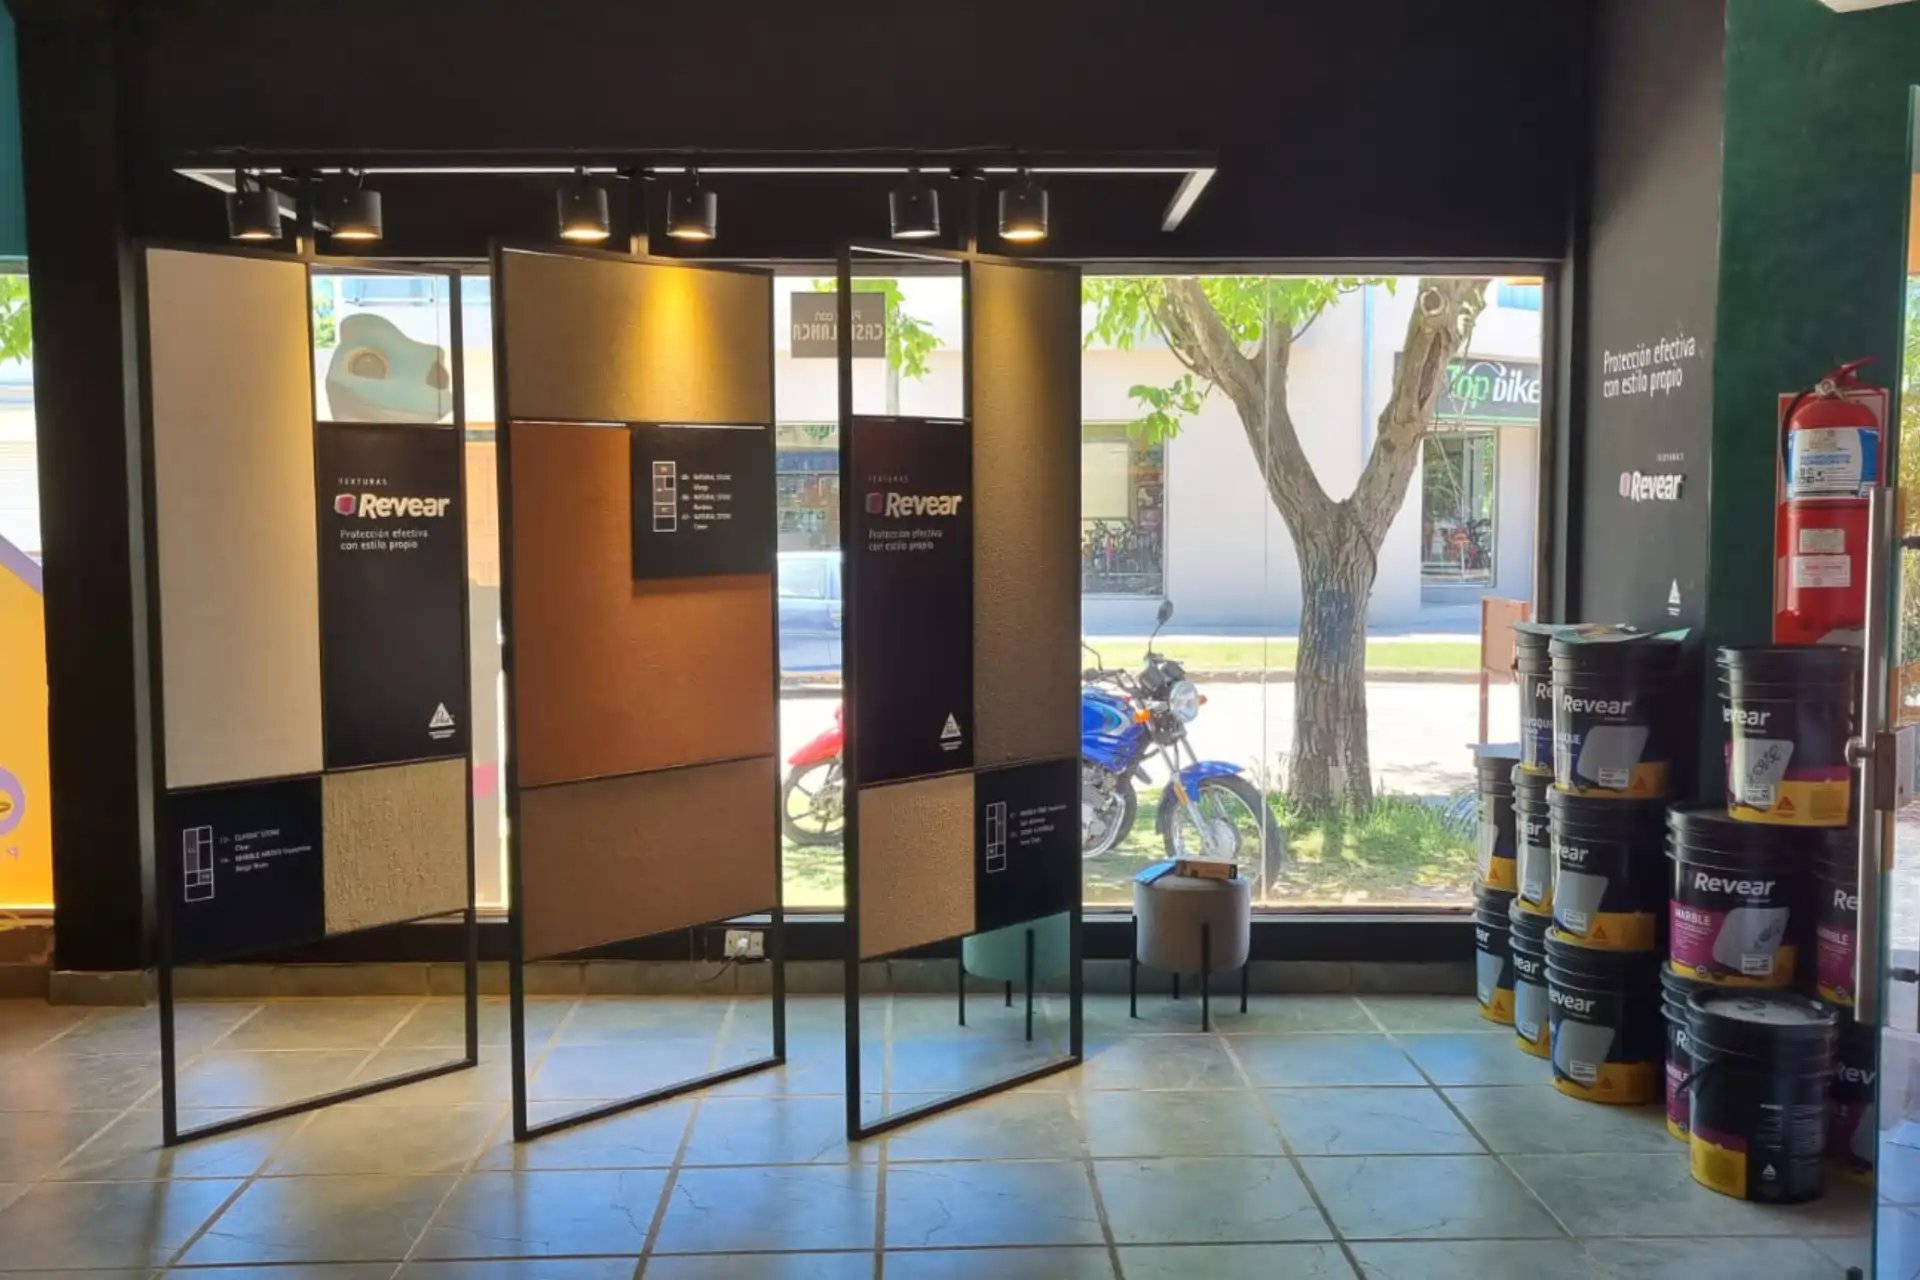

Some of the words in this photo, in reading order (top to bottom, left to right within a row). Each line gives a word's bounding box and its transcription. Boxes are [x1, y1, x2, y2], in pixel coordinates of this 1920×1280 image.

[1603, 342, 1651, 375] Protección
[1654, 333, 1696, 364] efectiva
[1603, 379, 1620, 398] con
[1621, 369, 1647, 395] estilo
[1649, 361, 1683, 398] propio
[338, 477, 388, 486] TEXTURAS
[1630, 470, 1683, 502] Revear
[358, 493, 451, 519] Revear
[884, 491, 963, 518] Revear
[340, 528, 389, 539] Protección
[391, 528, 429, 538] efectiva
[340, 542, 358, 551] con
[361, 540, 387, 550] estilo
[389, 540, 418, 552] propio
[868, 543, 883, 552] con
[1563, 694, 1632, 715] Revear
[1694, 871, 1776, 897] Revear
